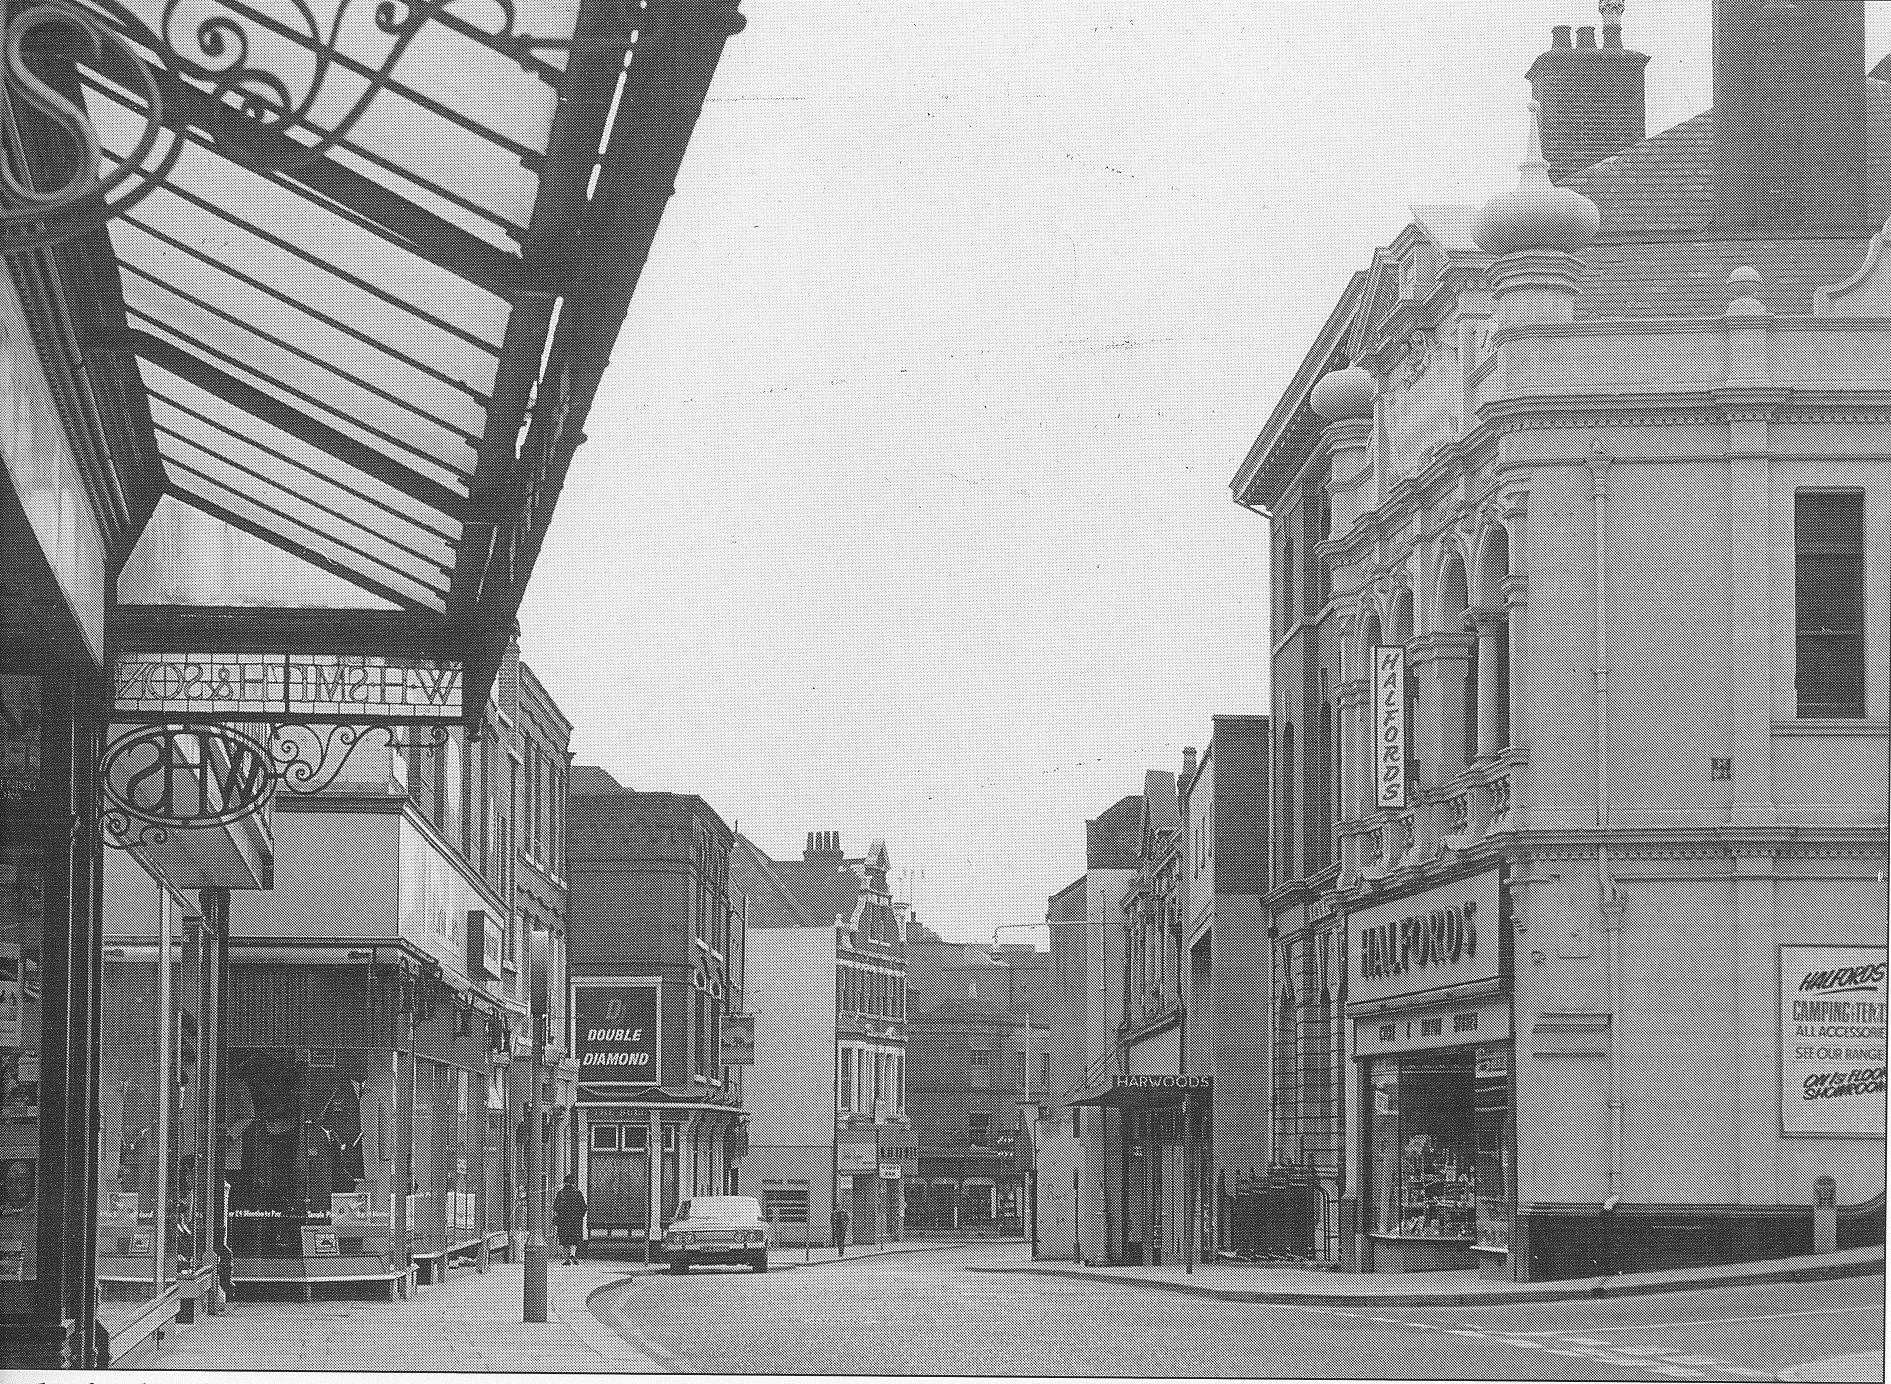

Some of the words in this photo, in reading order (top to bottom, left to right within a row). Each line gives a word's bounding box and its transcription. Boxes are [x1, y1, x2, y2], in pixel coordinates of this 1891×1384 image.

[1381, 653, 1401, 801] HALFORDS
[1361, 901, 1478, 980] HALFORDS
[1799, 963, 1886, 991] HALFORDS
[1793, 1000, 1850, 1023] CAMPING
[587, 1028, 642, 1042] DOUBLE
[1796, 1025, 1816, 1037] ALL
[583, 1052, 649, 1066] DIAMOND
[1795, 1047, 1814, 1060] SEE
[1816, 1047, 1843, 1060] OUR
[1845, 1048, 1884, 1060] RANGE
[1117, 1076, 1209, 1088] HARWOODS
[1803, 1074, 1831, 1088] ON
